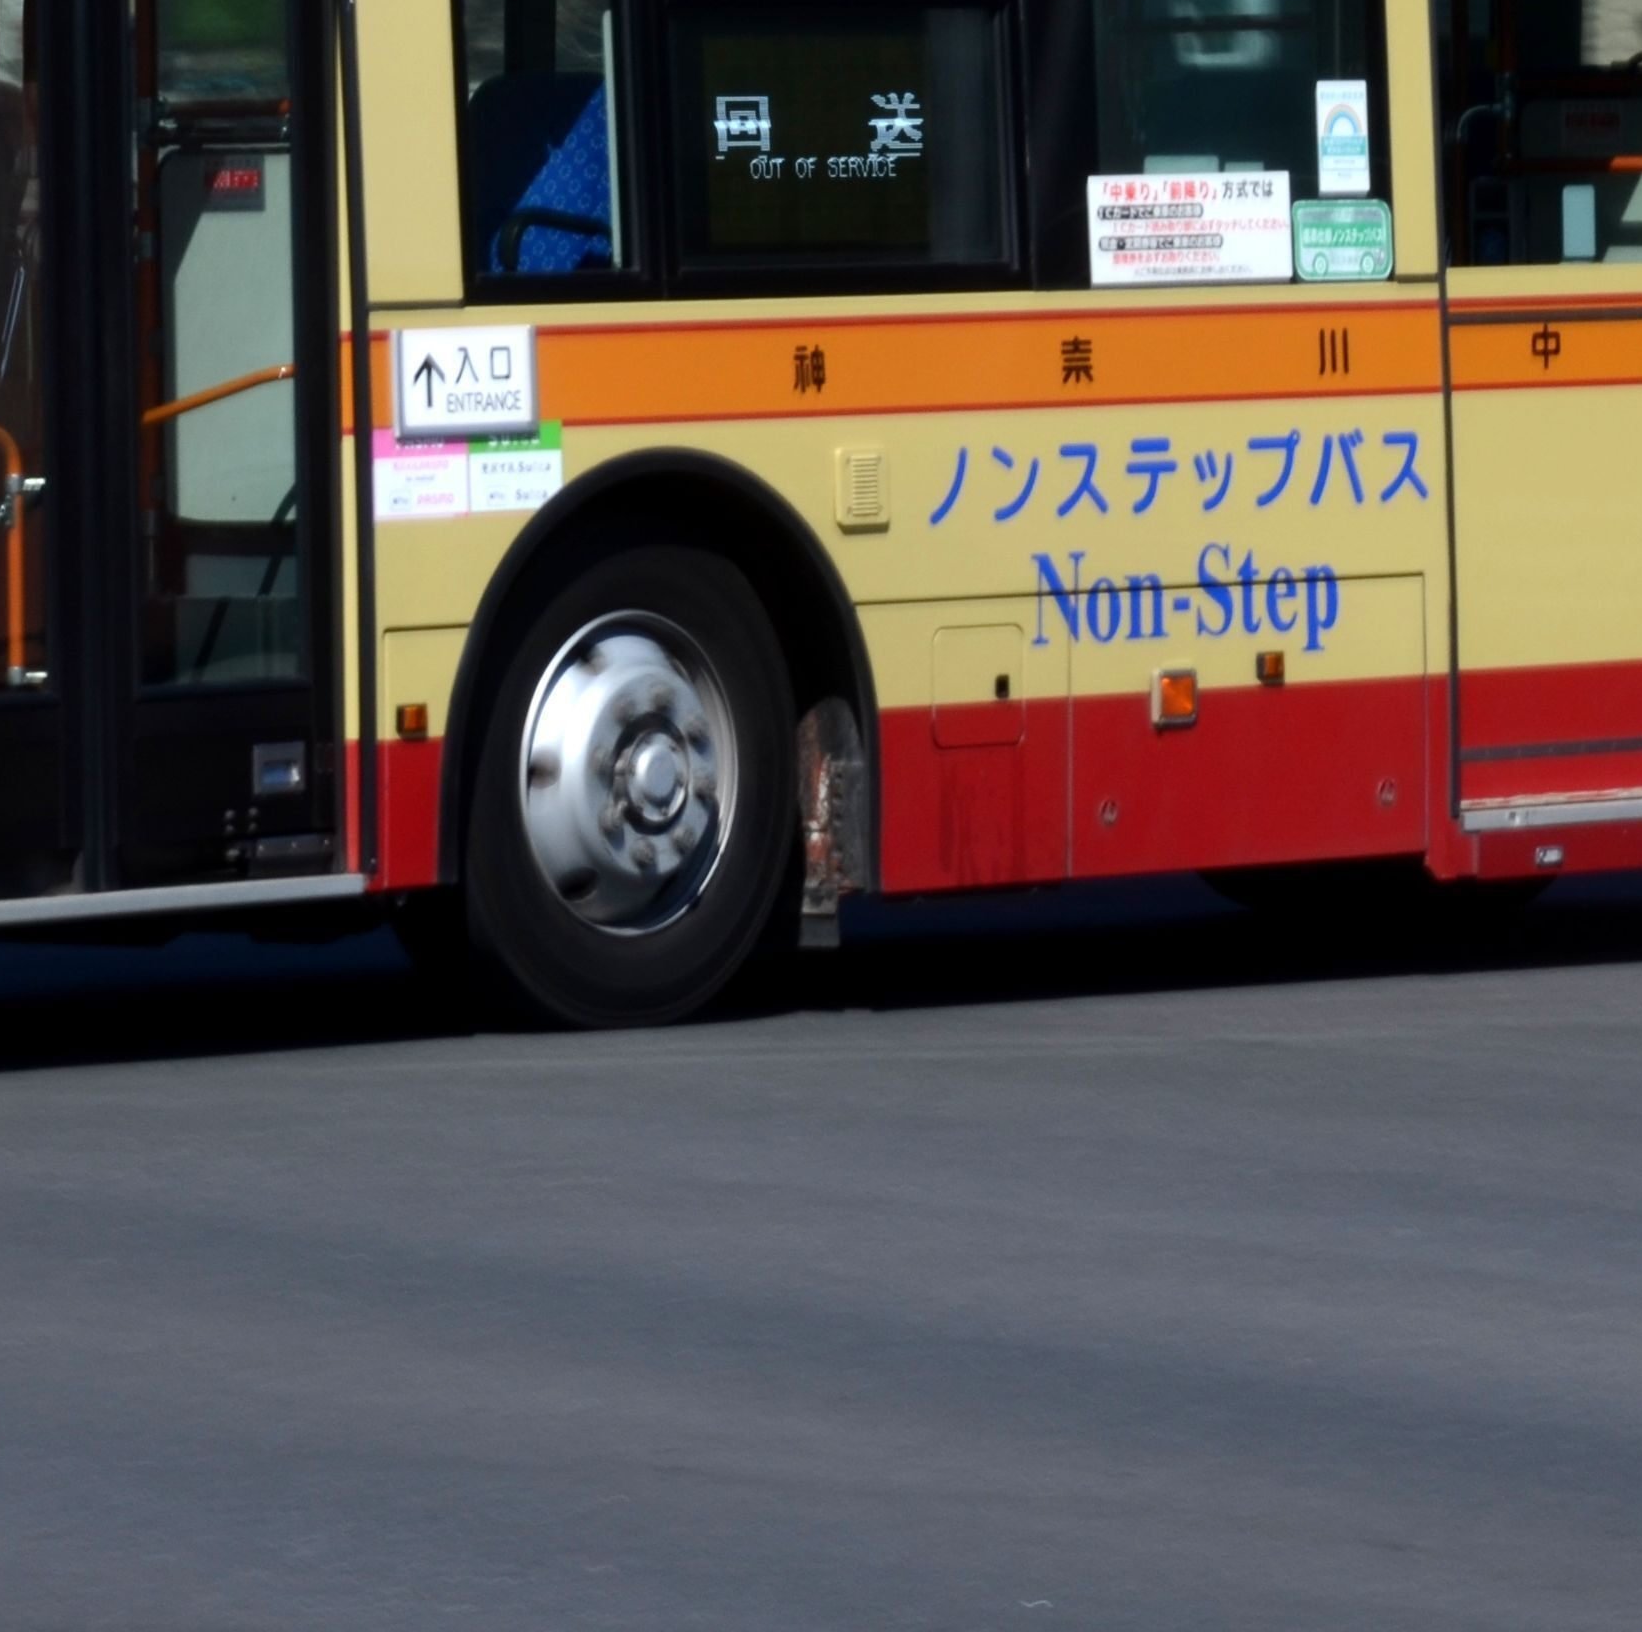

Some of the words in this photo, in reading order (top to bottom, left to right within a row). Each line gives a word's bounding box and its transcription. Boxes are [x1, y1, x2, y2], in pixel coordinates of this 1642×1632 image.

[750, 157, 785, 179] OUT
[795, 157, 817, 179] OF
[827, 155, 897, 177] SERVICE
[455, 346, 512, 384] 入口
[446, 390, 522, 413] ENTRANCE
[930, 430, 1429, 525] ノンステップバス
[1031, 543, 1340, 651] Non-Step
